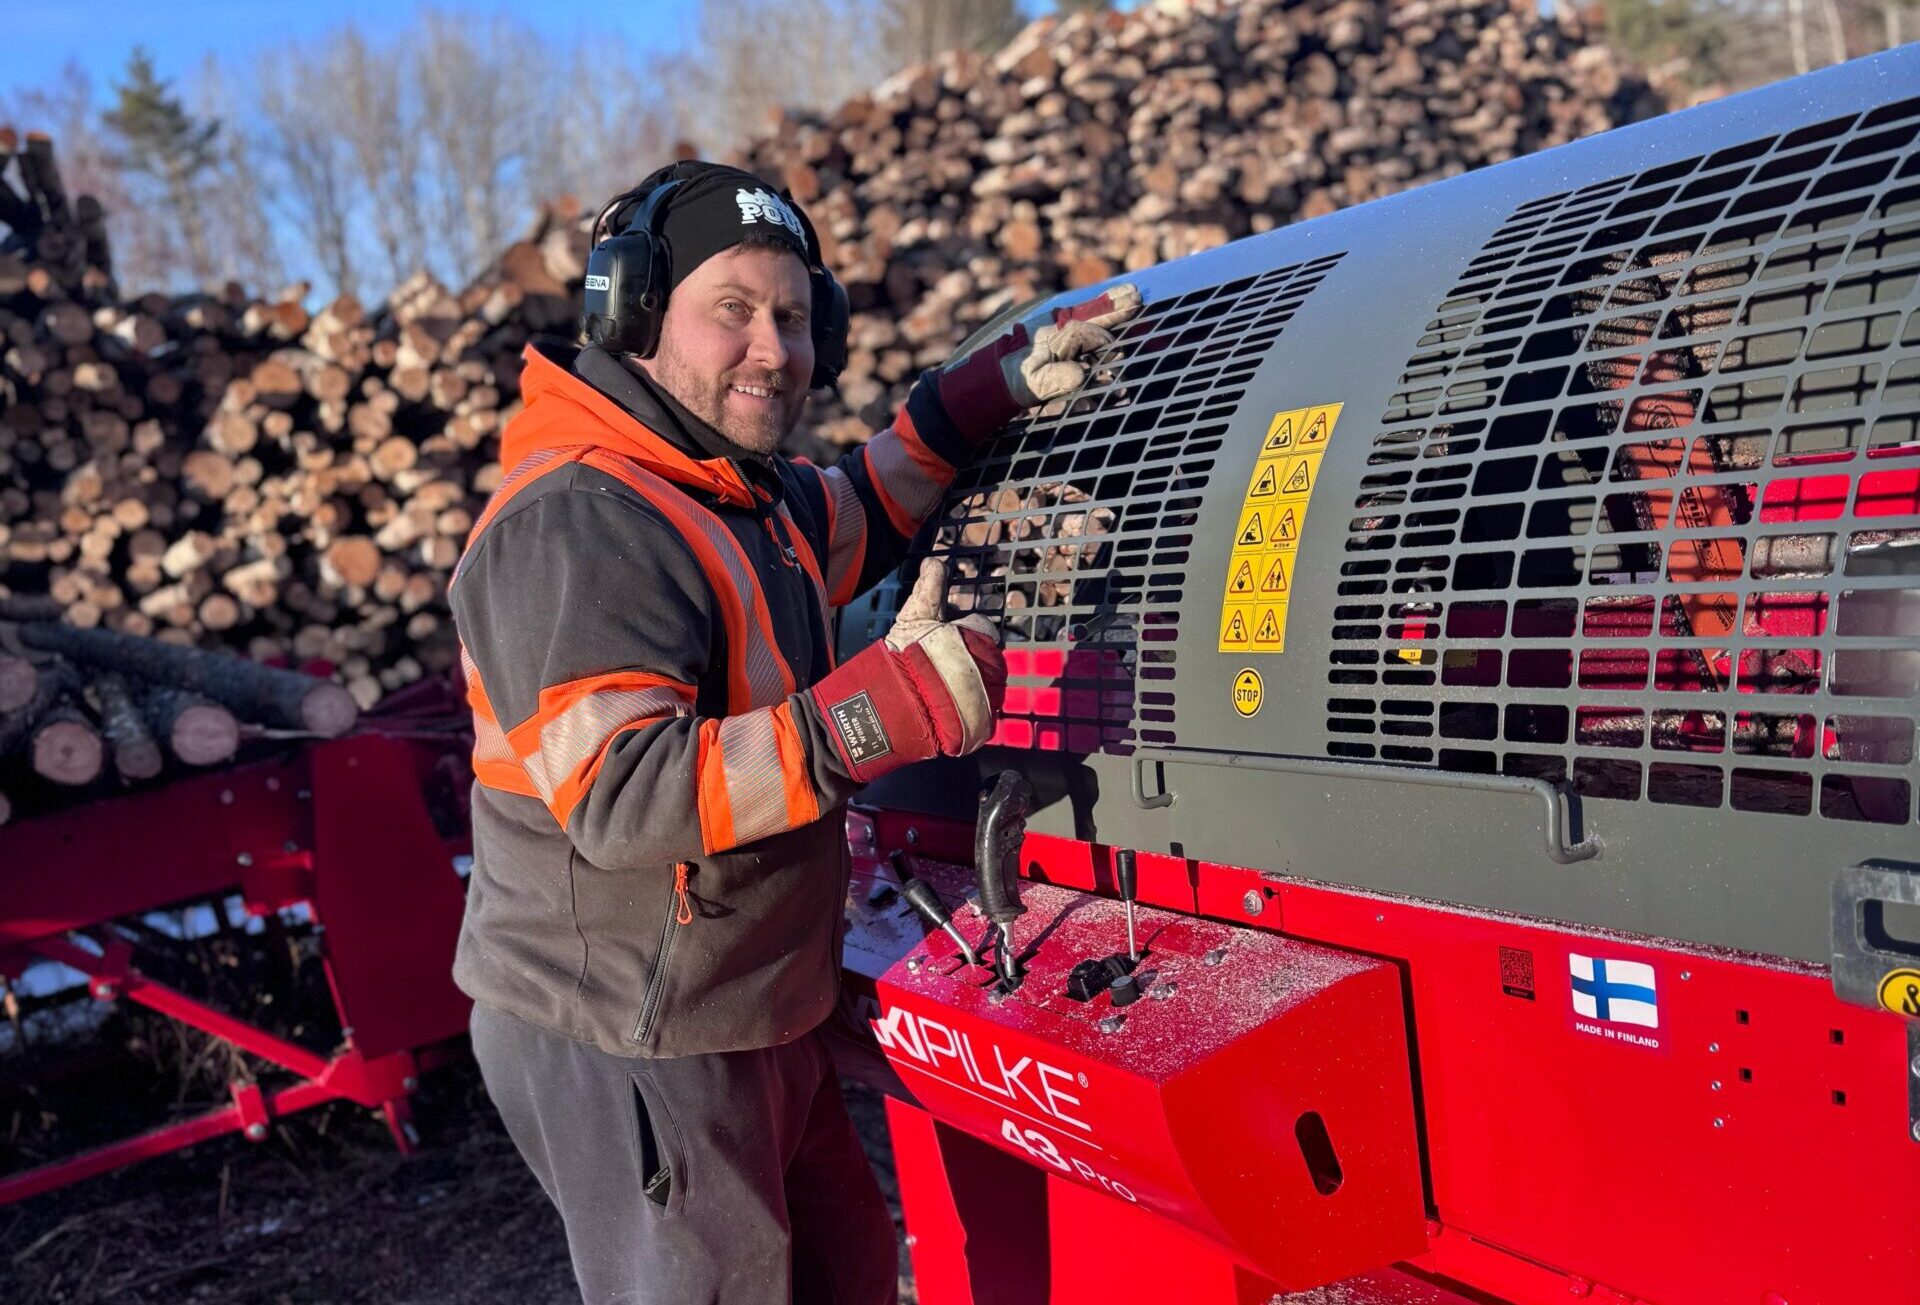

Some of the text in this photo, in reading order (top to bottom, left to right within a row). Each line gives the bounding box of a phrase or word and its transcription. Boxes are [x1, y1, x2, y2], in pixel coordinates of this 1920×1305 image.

[1236, 688, 1259, 703] STOP
[851, 716, 867, 744] WINTER
[1575, 1022, 1660, 1049] MADE IN FINLAND
[1002, 1118, 1137, 1203] 43 Pro
